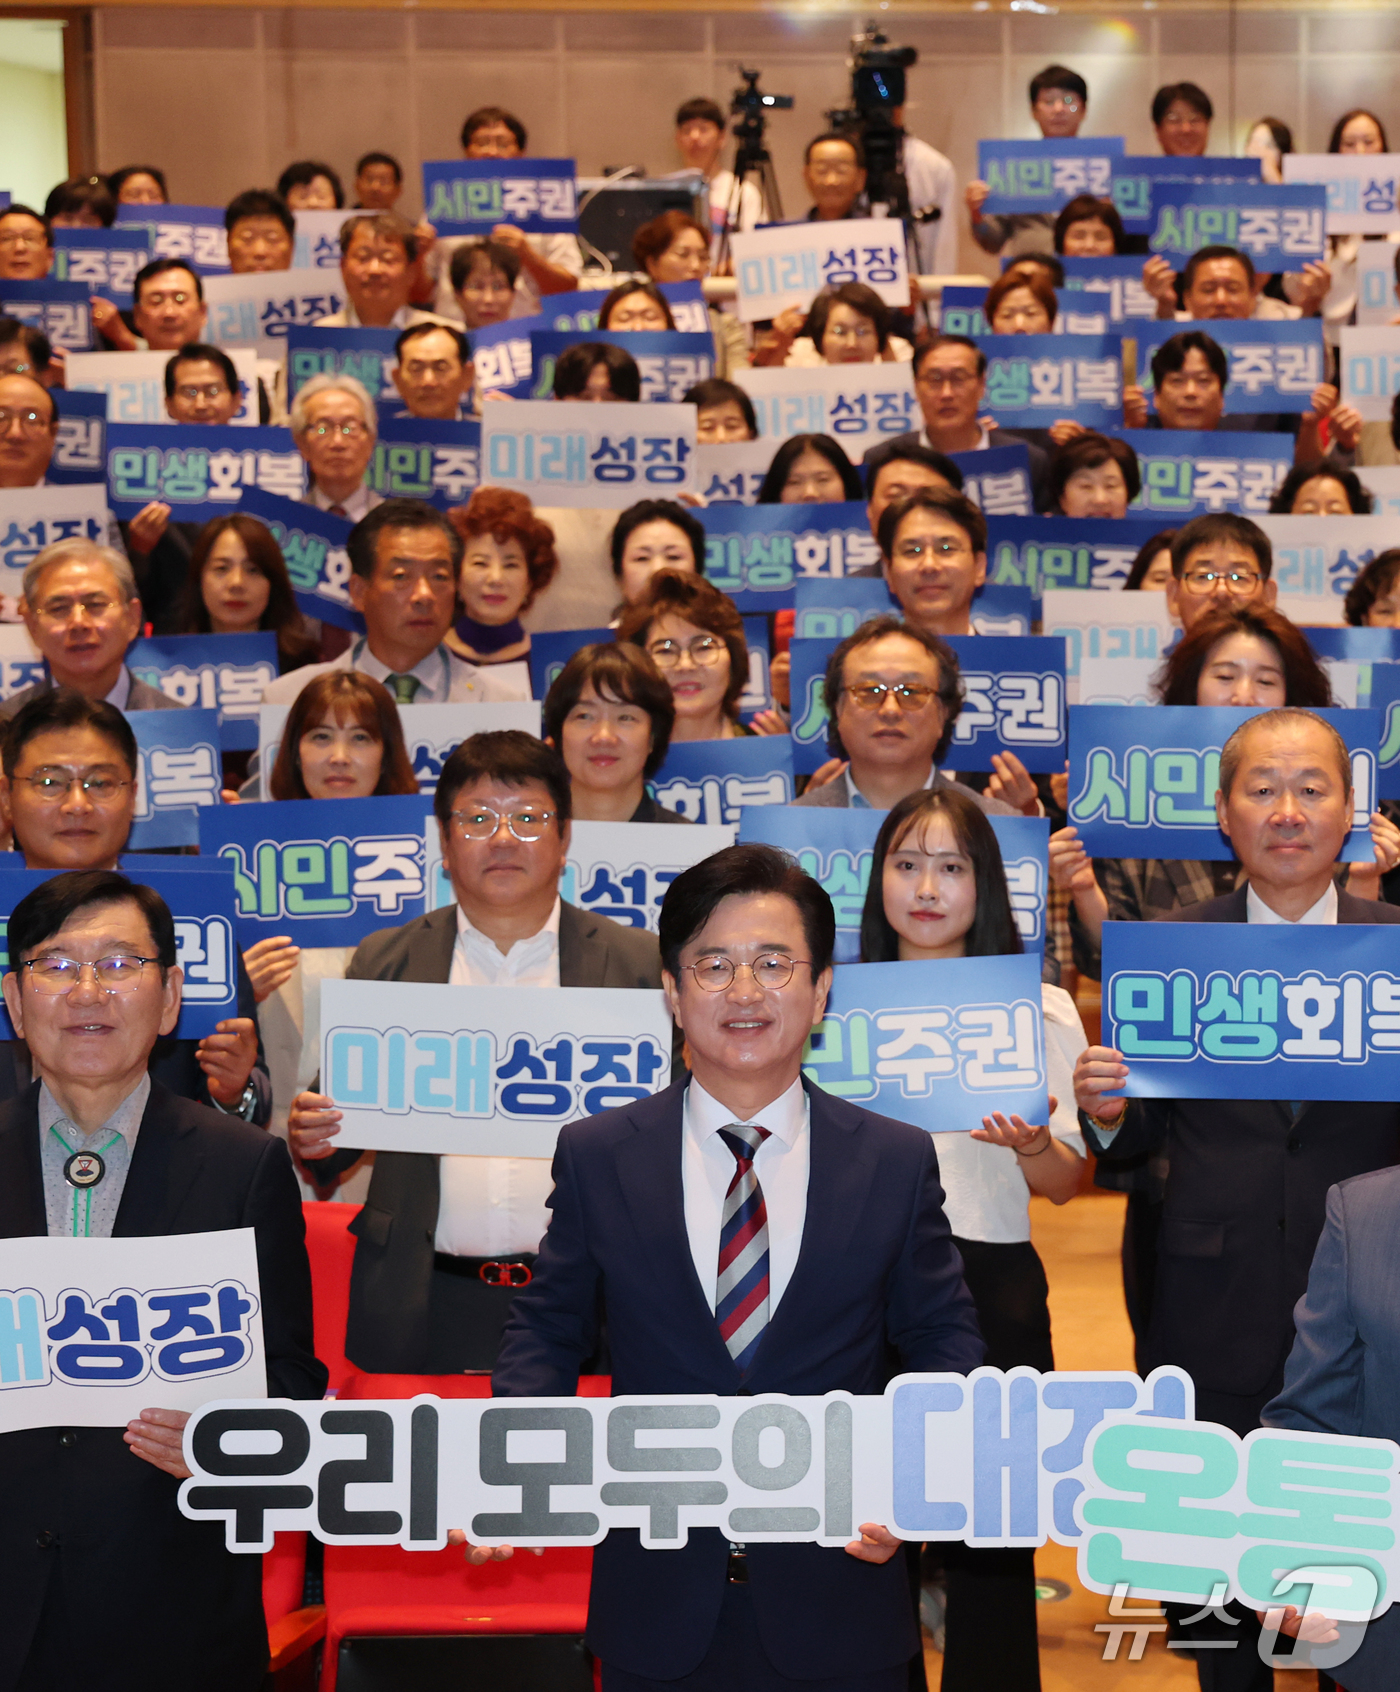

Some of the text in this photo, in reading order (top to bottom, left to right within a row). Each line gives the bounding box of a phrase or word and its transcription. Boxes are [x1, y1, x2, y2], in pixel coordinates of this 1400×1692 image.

[429, 179, 577, 220] 시민주권
[1152, 207, 1324, 253] 시민주권
[55, 250, 149, 293] 주권
[741, 246, 901, 297] 미래성장
[294, 352, 400, 399] 민생
[986, 360, 1120, 407] 생회복
[113, 450, 303, 501] 민생회복
[489, 433, 692, 483] 미래성장
[1131, 460, 1289, 510] 민주권
[995, 546, 1139, 594] 시민주
[1052, 626, 1184, 677] 미래
[135, 667, 271, 716] 회복
[224, 840, 424, 916] 시민주
[331, 1031, 664, 1116] 미래성장
[801, 1005, 1040, 1095] 민주권
[186, 1403, 440, 1544] 우리
[471, 1400, 853, 1540] 모두의
[1082, 1422, 1396, 1612] 온통
